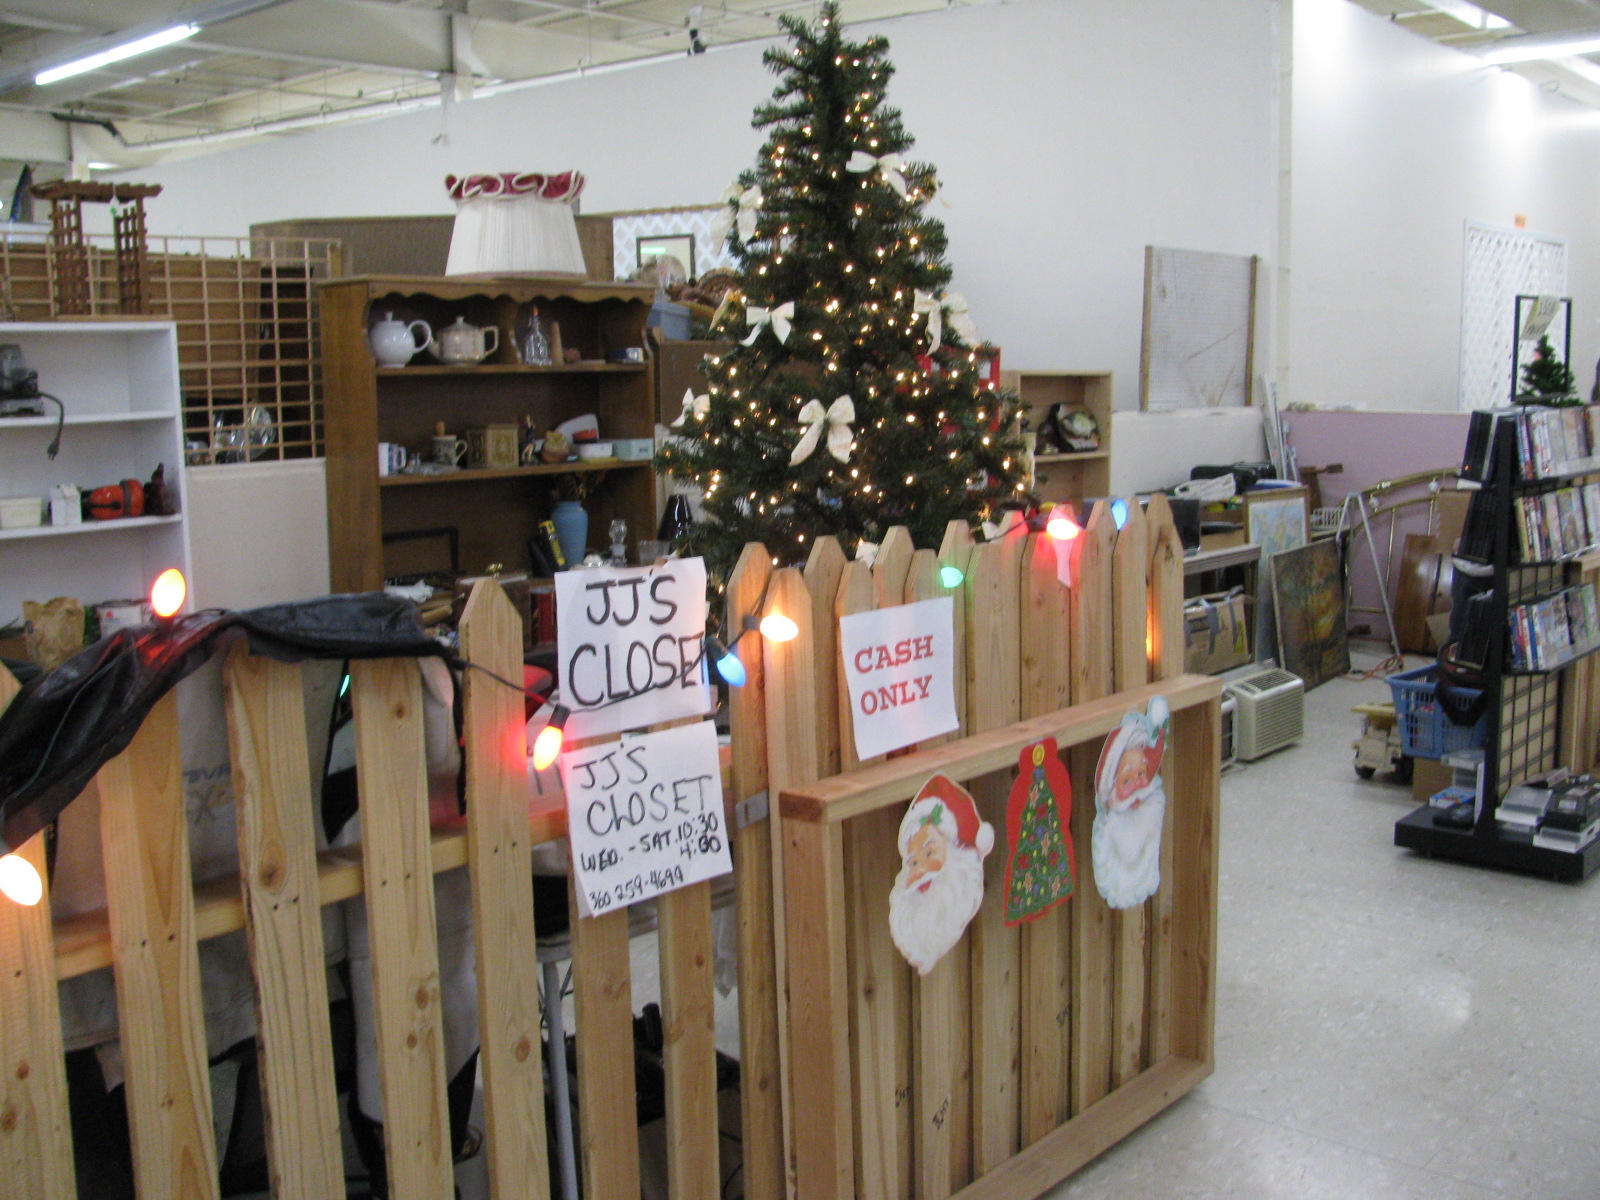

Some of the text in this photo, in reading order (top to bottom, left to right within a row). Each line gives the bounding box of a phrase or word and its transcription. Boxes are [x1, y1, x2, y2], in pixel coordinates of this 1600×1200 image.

[585, 568, 678, 626] JJ'S
[854, 634, 934, 674] CASH
[860, 674, 933, 716] ONLY
[572, 742, 649, 790] JJ'S
[586, 774, 713, 837] CLOSET
[588, 889, 612, 911] 360
